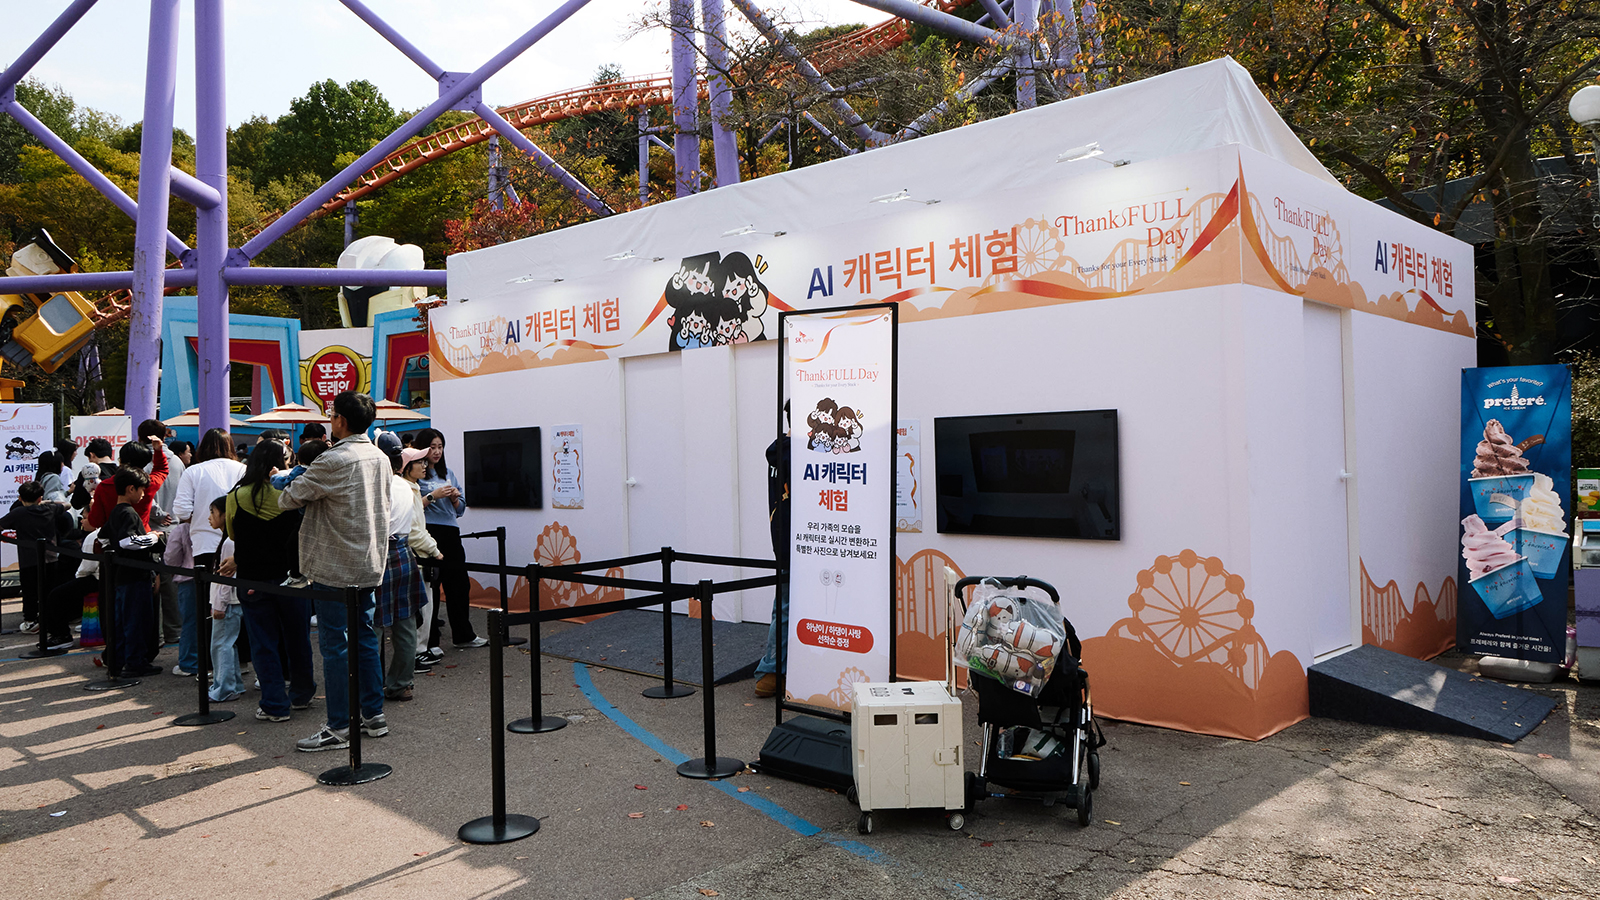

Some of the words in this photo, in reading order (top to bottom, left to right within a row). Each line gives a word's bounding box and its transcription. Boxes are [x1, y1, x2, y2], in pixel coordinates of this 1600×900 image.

[1146, 227, 1189, 249] Day
[1313, 236, 1330, 264] Day
[807, 265, 834, 300] AI
[843, 241, 936, 294] 캐릭터
[948, 226, 1019, 279] 체험
[1077, 265, 1100, 275] Thanks
[1101, 262, 1110, 271] for
[1111, 261, 1127, 271] your
[1128, 258, 1148, 268] Every
[1149, 254, 1168, 264] Stack
[1374, 240, 1388, 275] AI
[1391, 242, 1428, 291] 캐릭터
[1431, 256, 1453, 298] 체험
[505, 319, 521, 345] AI
[525, 305, 577, 343] 캐릭터
[582, 297, 620, 334] 체험
[479, 335, 494, 351] Day
[316, 362, 350, 379] 또봇
[858, 368, 879, 382] Day
[4, 465, 14, 473] AI
[803, 463, 819, 481] AI
[821, 462, 867, 485] 캐릭터
[818, 489, 848, 511] 체험
[807, 522, 820, 531] 우리
[820, 522, 840, 532] 가족의
[841, 524, 861, 534] 모습을
[803, 534, 826, 544] 캐릭터로
[828, 536, 848, 546] 실시간
[848, 537, 877, 547] 변환하고
[796, 544, 812, 554] 특별한
[814, 546, 838, 556] 사진으로
[840, 548, 877, 560] 남겨보세요!
[818, 634, 836, 646] 선착순
[836, 637, 850, 648] 증정
[848, 629, 861, 639] 사탕
[1512, 642, 1530, 651] 즐거운
